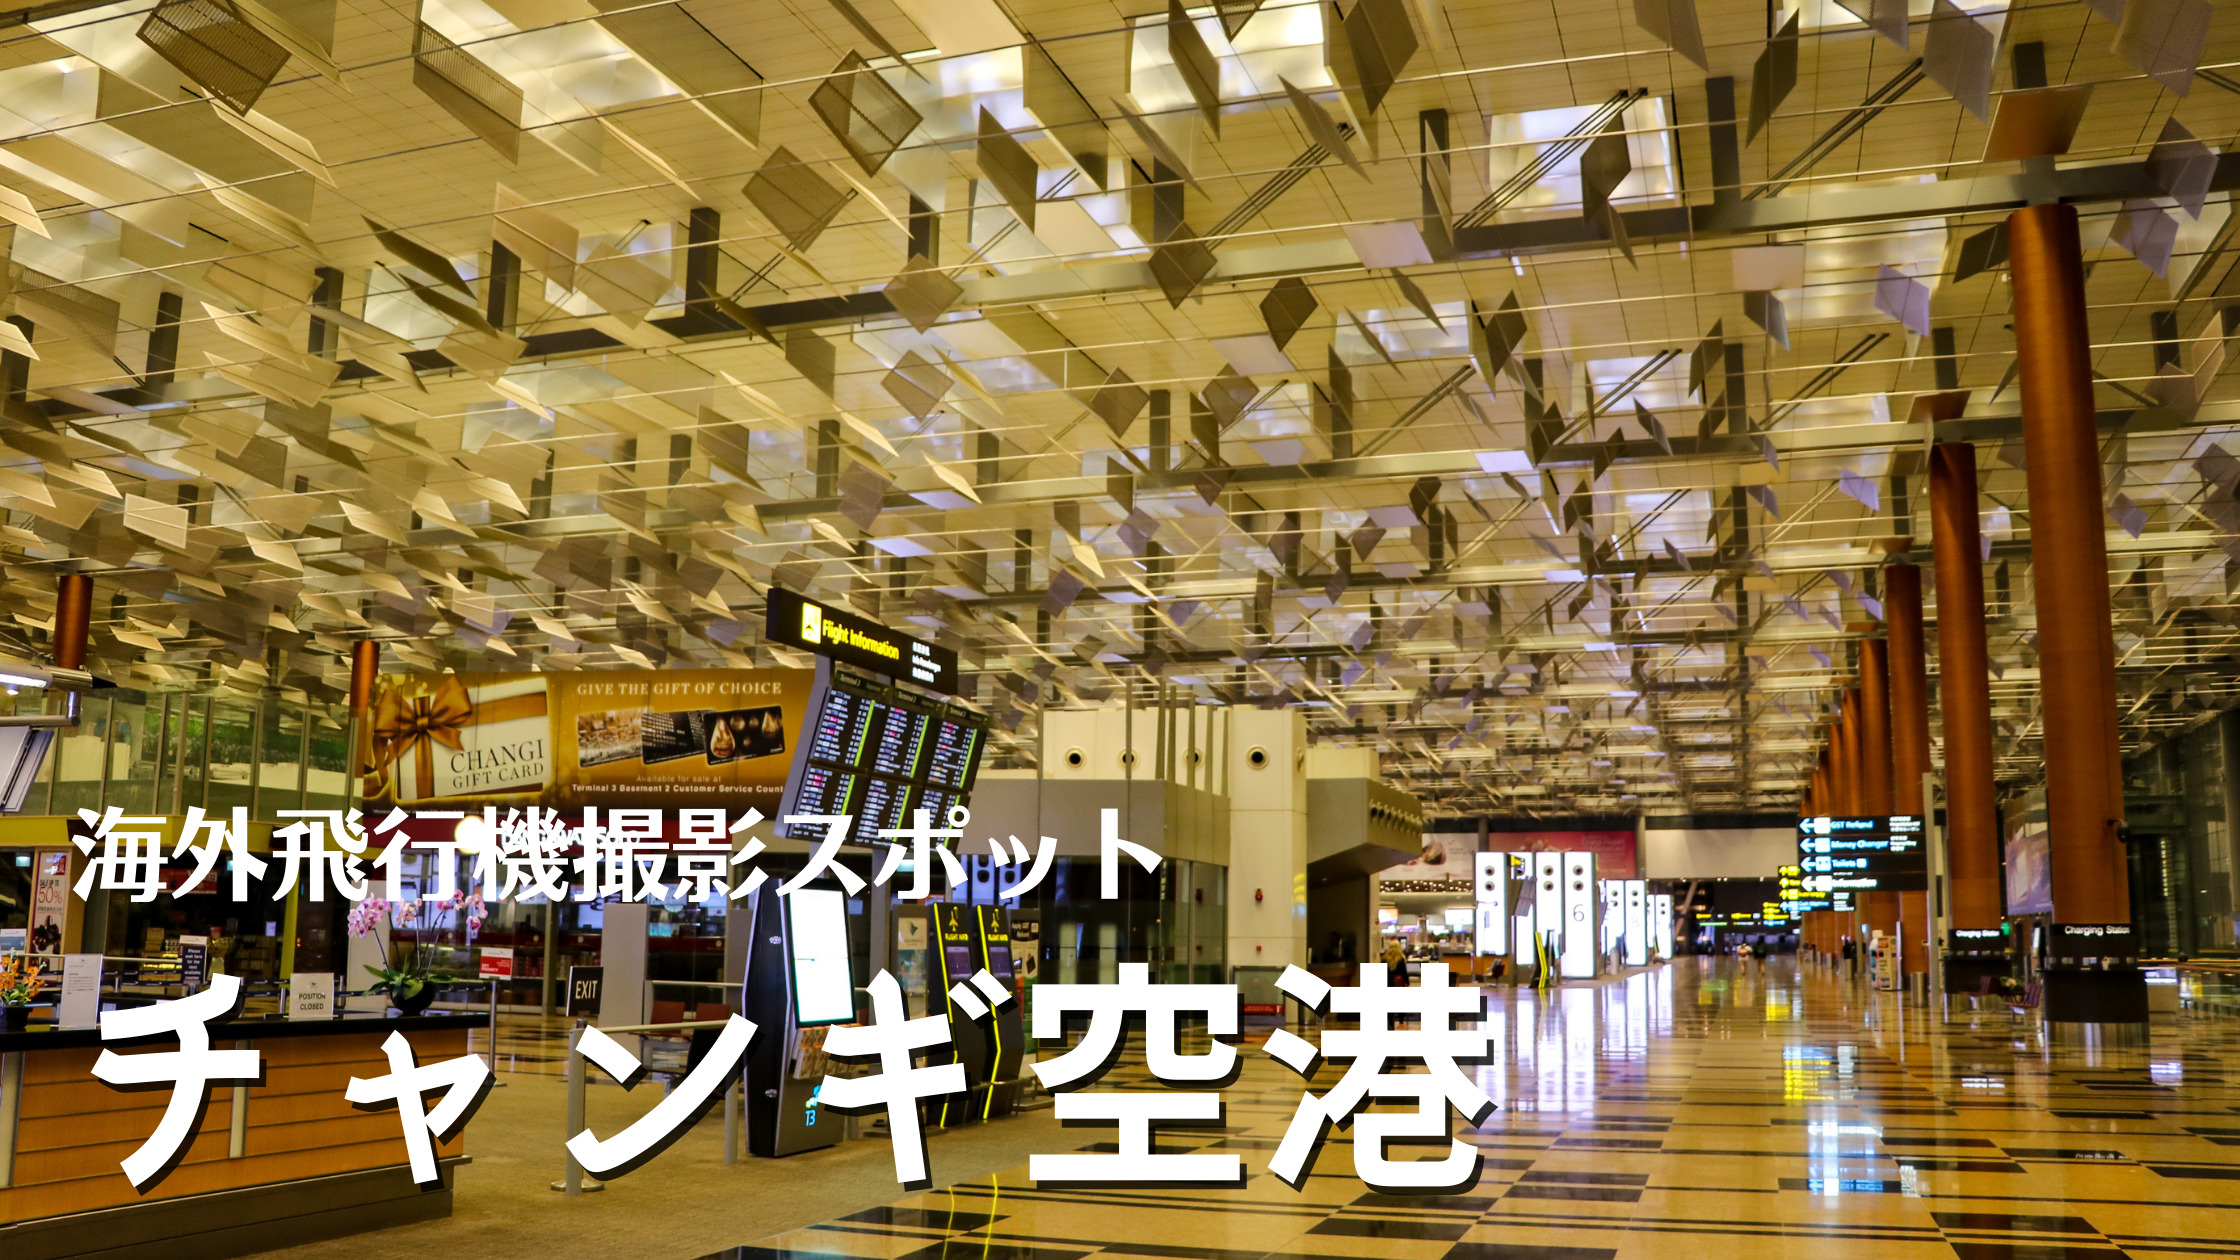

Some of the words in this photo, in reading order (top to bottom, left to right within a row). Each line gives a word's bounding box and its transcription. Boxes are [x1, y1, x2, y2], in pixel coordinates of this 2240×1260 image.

[822, 619, 849, 645] Flight
[850, 628, 900, 660] Information
[577, 683, 614, 695] GIVE
[619, 683, 649, 695] THE
[653, 682, 691, 695] GIFT
[694, 682, 715, 695] OF
[719, 682, 782, 695] CHOICE
[451, 739, 544, 774] CHANGI
[452, 771, 492, 789] GIFT
[498, 762, 544, 782] CARD
[636, 775, 674, 783] Available
[677, 775, 689, 783] for
[572, 784, 609, 792] Terminal
[611, 784, 617, 792] 3
[619, 784, 662, 793] Basement
[665, 784, 671, 793] 2
[673, 784, 716, 793] Customer
[719, 785, 753, 793] Service
[1831, 820, 1845, 829] GST
[1846, 819, 1874, 829] Refund
[1831, 840, 1857, 851] Money
[1857, 839, 1889, 850] Changer
[1832, 858, 1856, 868] Toilets
[38, 886, 62, 904] 50%
[1572, 903, 1585, 922] 6
[2065, 925, 2104, 937] Charging
[2105, 925, 2130, 935] Station
[575, 980, 598, 1000] EXIT
